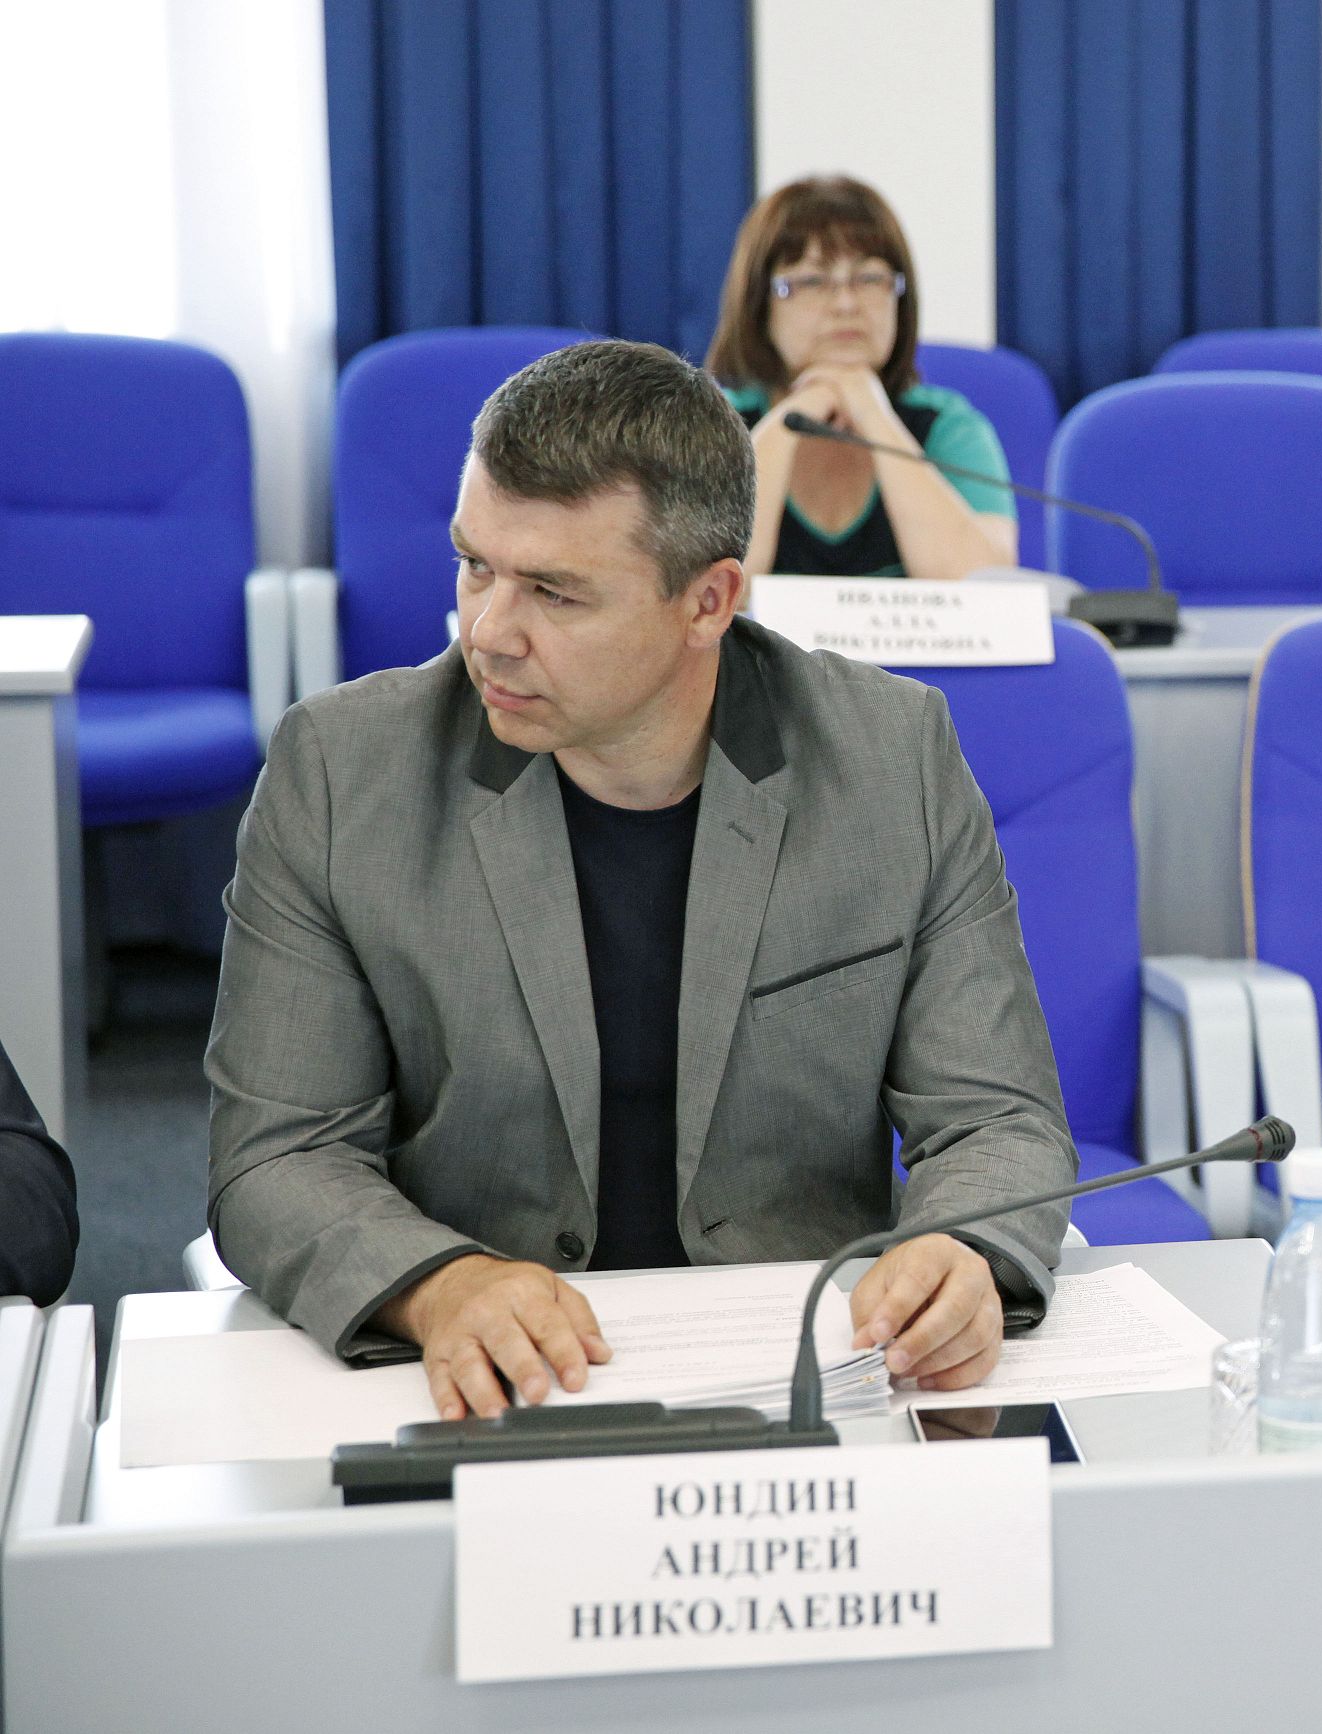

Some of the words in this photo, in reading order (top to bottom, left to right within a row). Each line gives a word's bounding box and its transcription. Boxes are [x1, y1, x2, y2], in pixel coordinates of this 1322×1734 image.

[655, 1478, 857, 1519] ЮНДИН
[653, 1526, 860, 1579] АНДРЕЙ
[571, 1589, 939, 1641] НИКОЛАЕВИЧ
